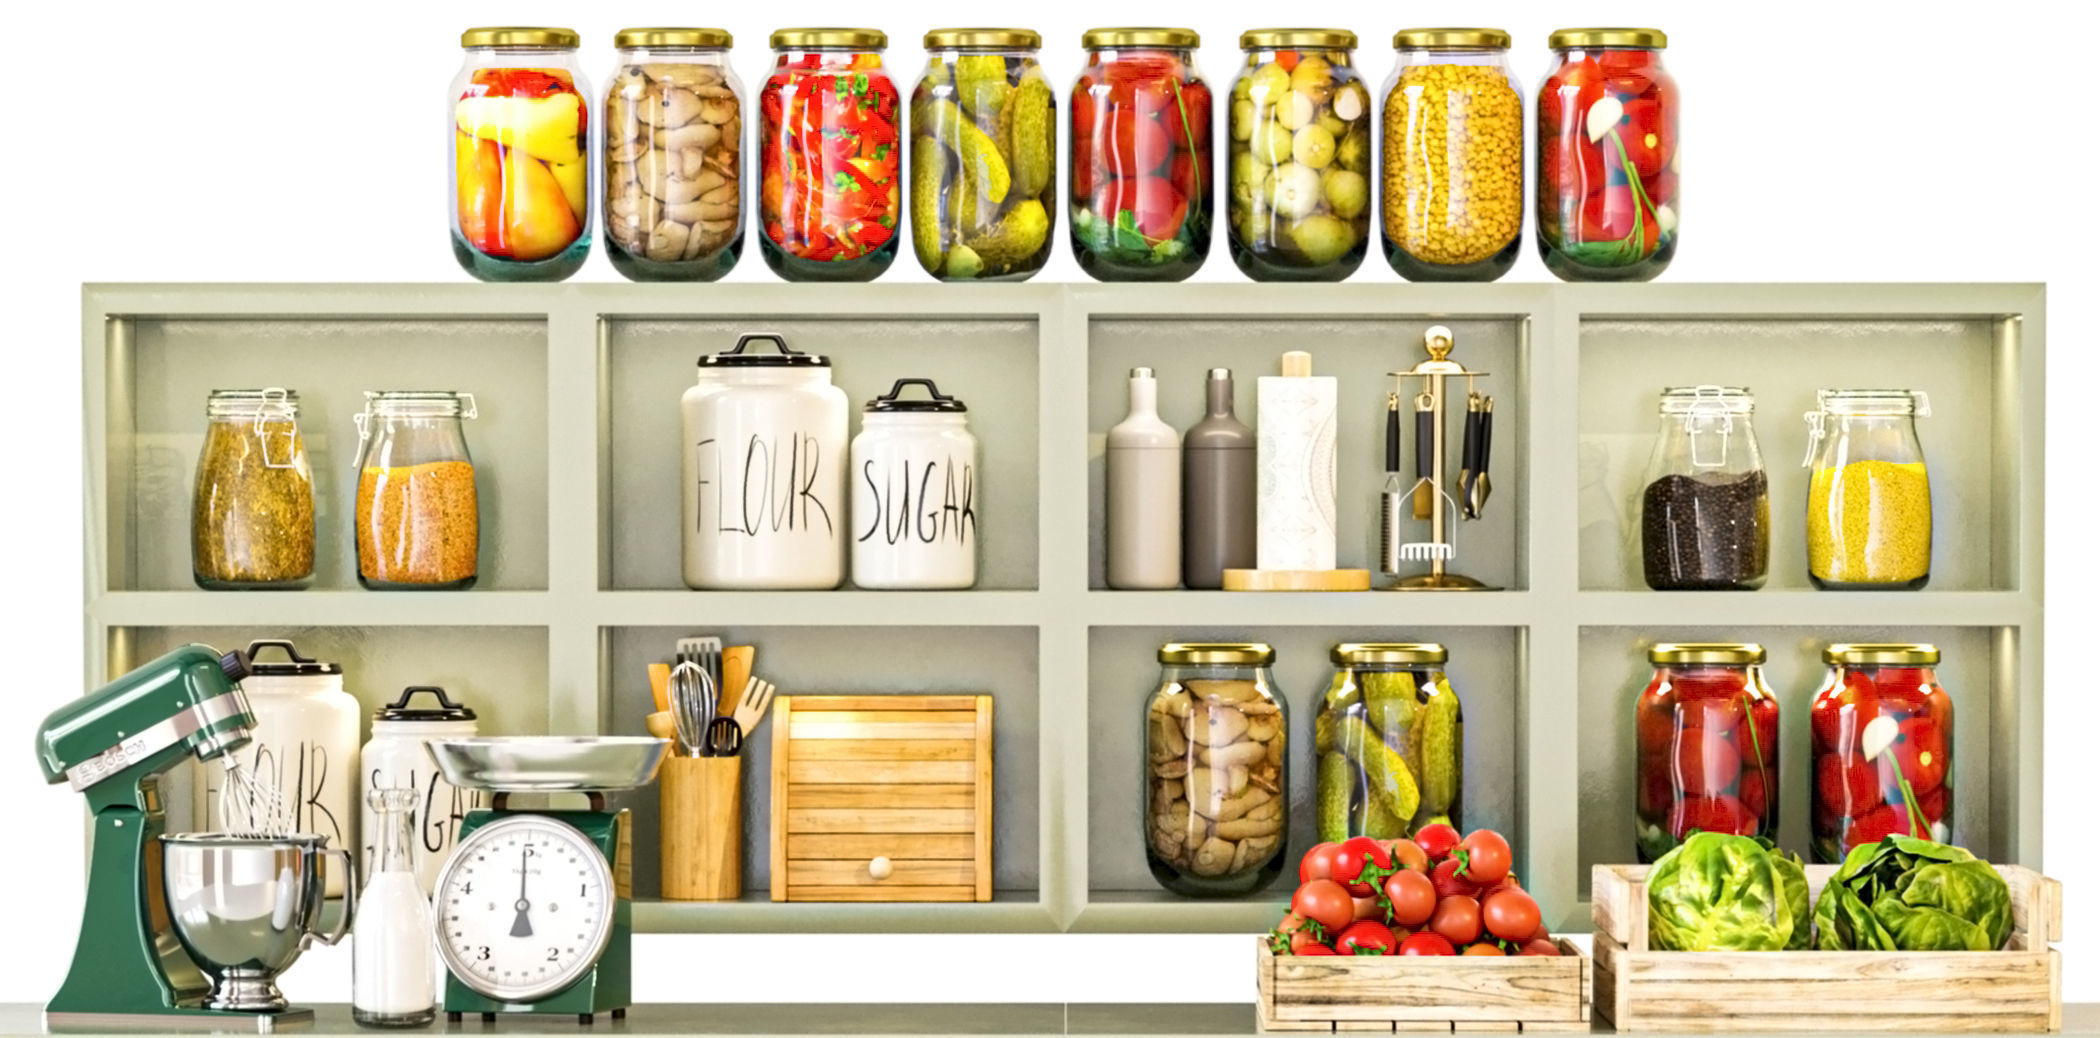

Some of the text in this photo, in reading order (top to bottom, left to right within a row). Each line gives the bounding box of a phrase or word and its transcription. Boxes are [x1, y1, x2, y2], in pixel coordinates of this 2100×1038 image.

[697, 431, 833, 538] FLOUR
[858, 454, 977, 547] SUGAR
[205, 739, 341, 846] FOUR
[522, 843, 535, 857] 5
[460, 881, 473, 895] 4
[580, 883, 587, 897] 1
[477, 946, 490, 960] 3
[547, 947, 559, 961] 2
